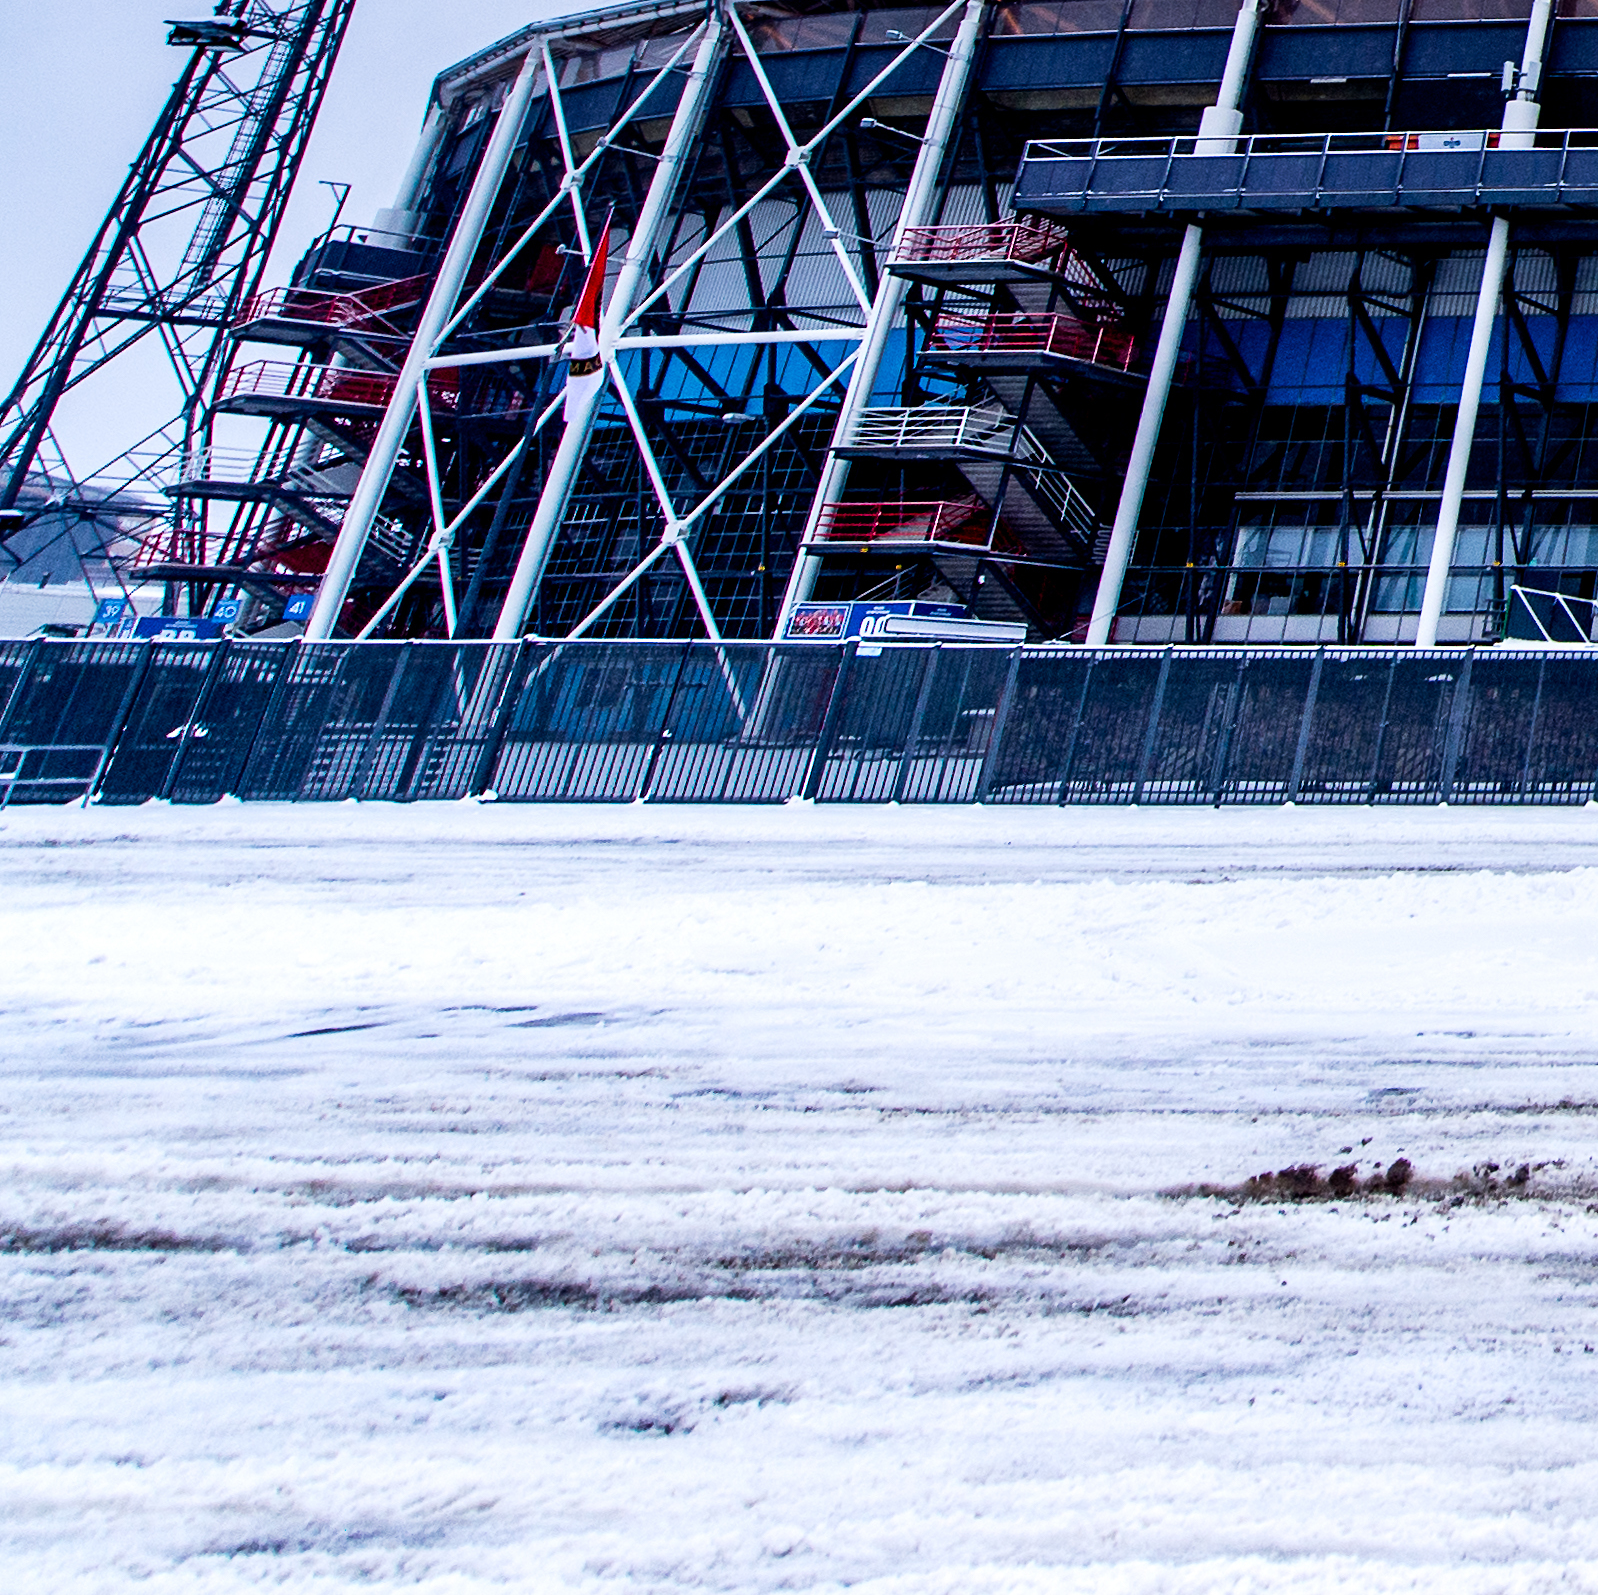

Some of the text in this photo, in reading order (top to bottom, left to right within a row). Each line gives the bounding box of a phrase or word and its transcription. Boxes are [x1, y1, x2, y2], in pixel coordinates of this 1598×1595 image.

[102, 605, 120, 618] 39
[214, 605, 237, 618] 40
[289, 601, 305, 614] 41
